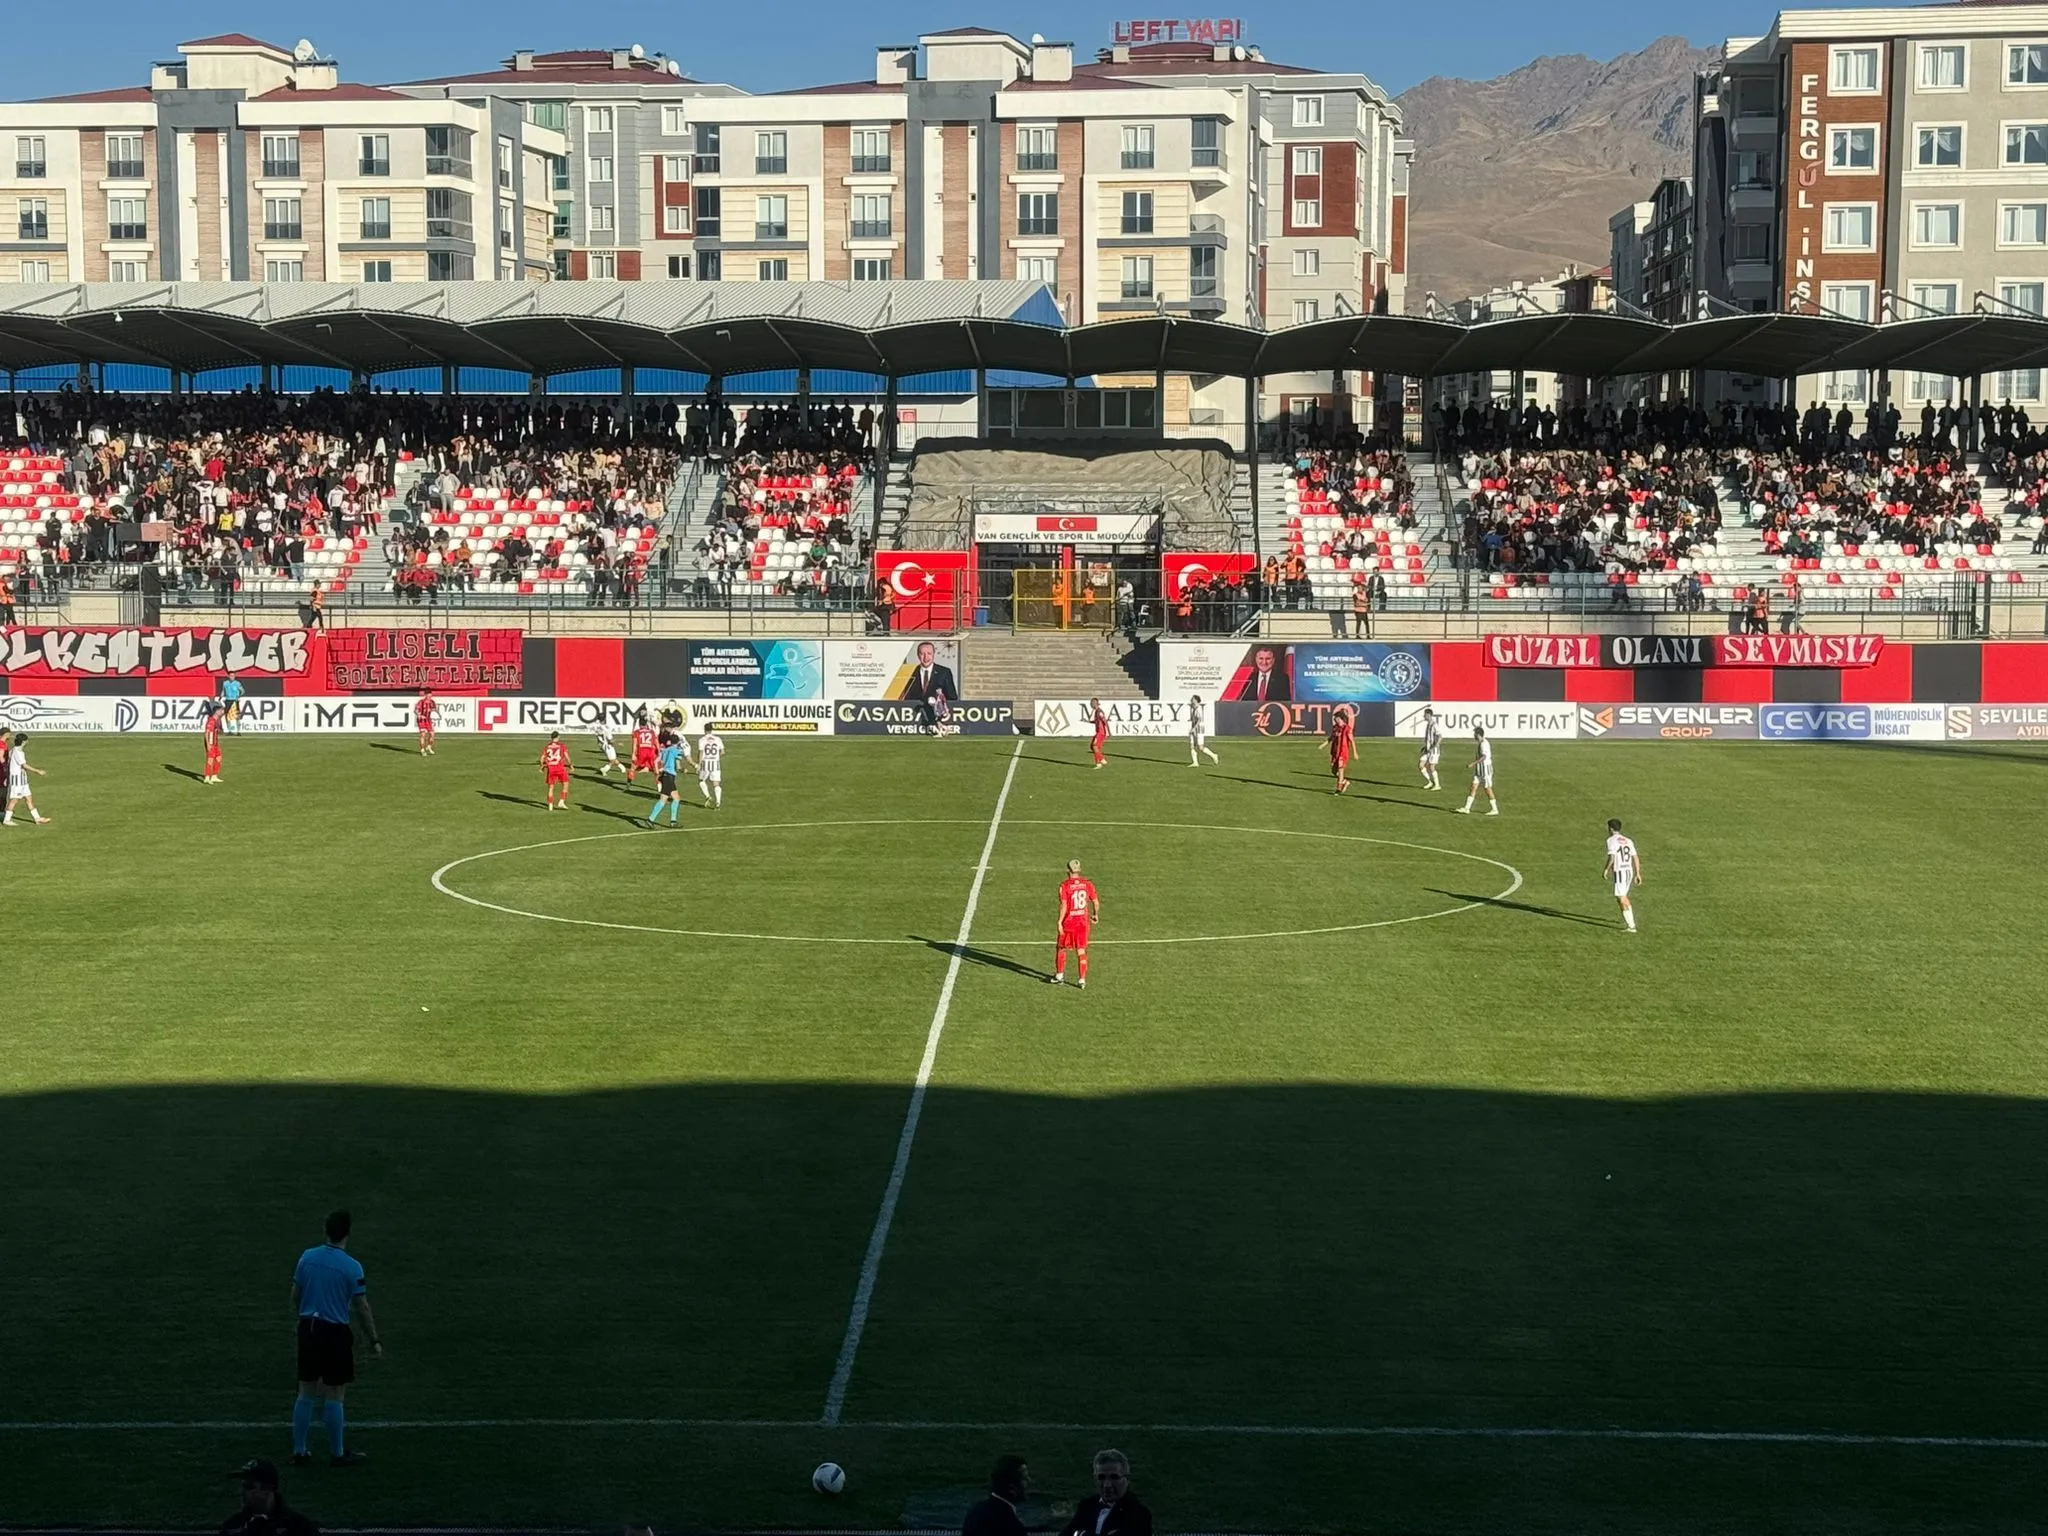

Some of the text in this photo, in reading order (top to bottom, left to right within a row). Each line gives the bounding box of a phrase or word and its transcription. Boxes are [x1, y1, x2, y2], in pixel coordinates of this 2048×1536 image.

[1115, 19, 1241, 42] LEFT YAPI
[977, 532, 997, 540] VAN
[999, 531, 1042, 542] GENÇLİK
[1043, 532, 1055, 540] VE
[1058, 532, 1083, 540] SPOR
[1085, 531, 1095, 540] İL
[1490, 634, 1881, 666] GÜZEL OLANI SEVMİŞİZ
[10, 707, 34, 715] BETA
[692, 704, 832, 719] VAN KAHVALTI LOUNGE
[1618, 706, 1754, 725] SEVENLER
[1874, 708, 1943, 721] MÜHENDİSLİK
[444, 718, 466, 728] YAPI
[1433, 713, 1570, 730] TURGUT FIRAT
[1765, 710, 1866, 736] ÇEVRE
[1660, 726, 1713, 738] GROUP
[1874, 722, 1911, 736] İNŞAAT
[2016, 724, 2048, 737] AYDI
[639, 732, 653, 745] 12
[704, 743, 718, 756] 66
[1616, 845, 1631, 862] 13
[1071, 889, 1087, 910] 18
